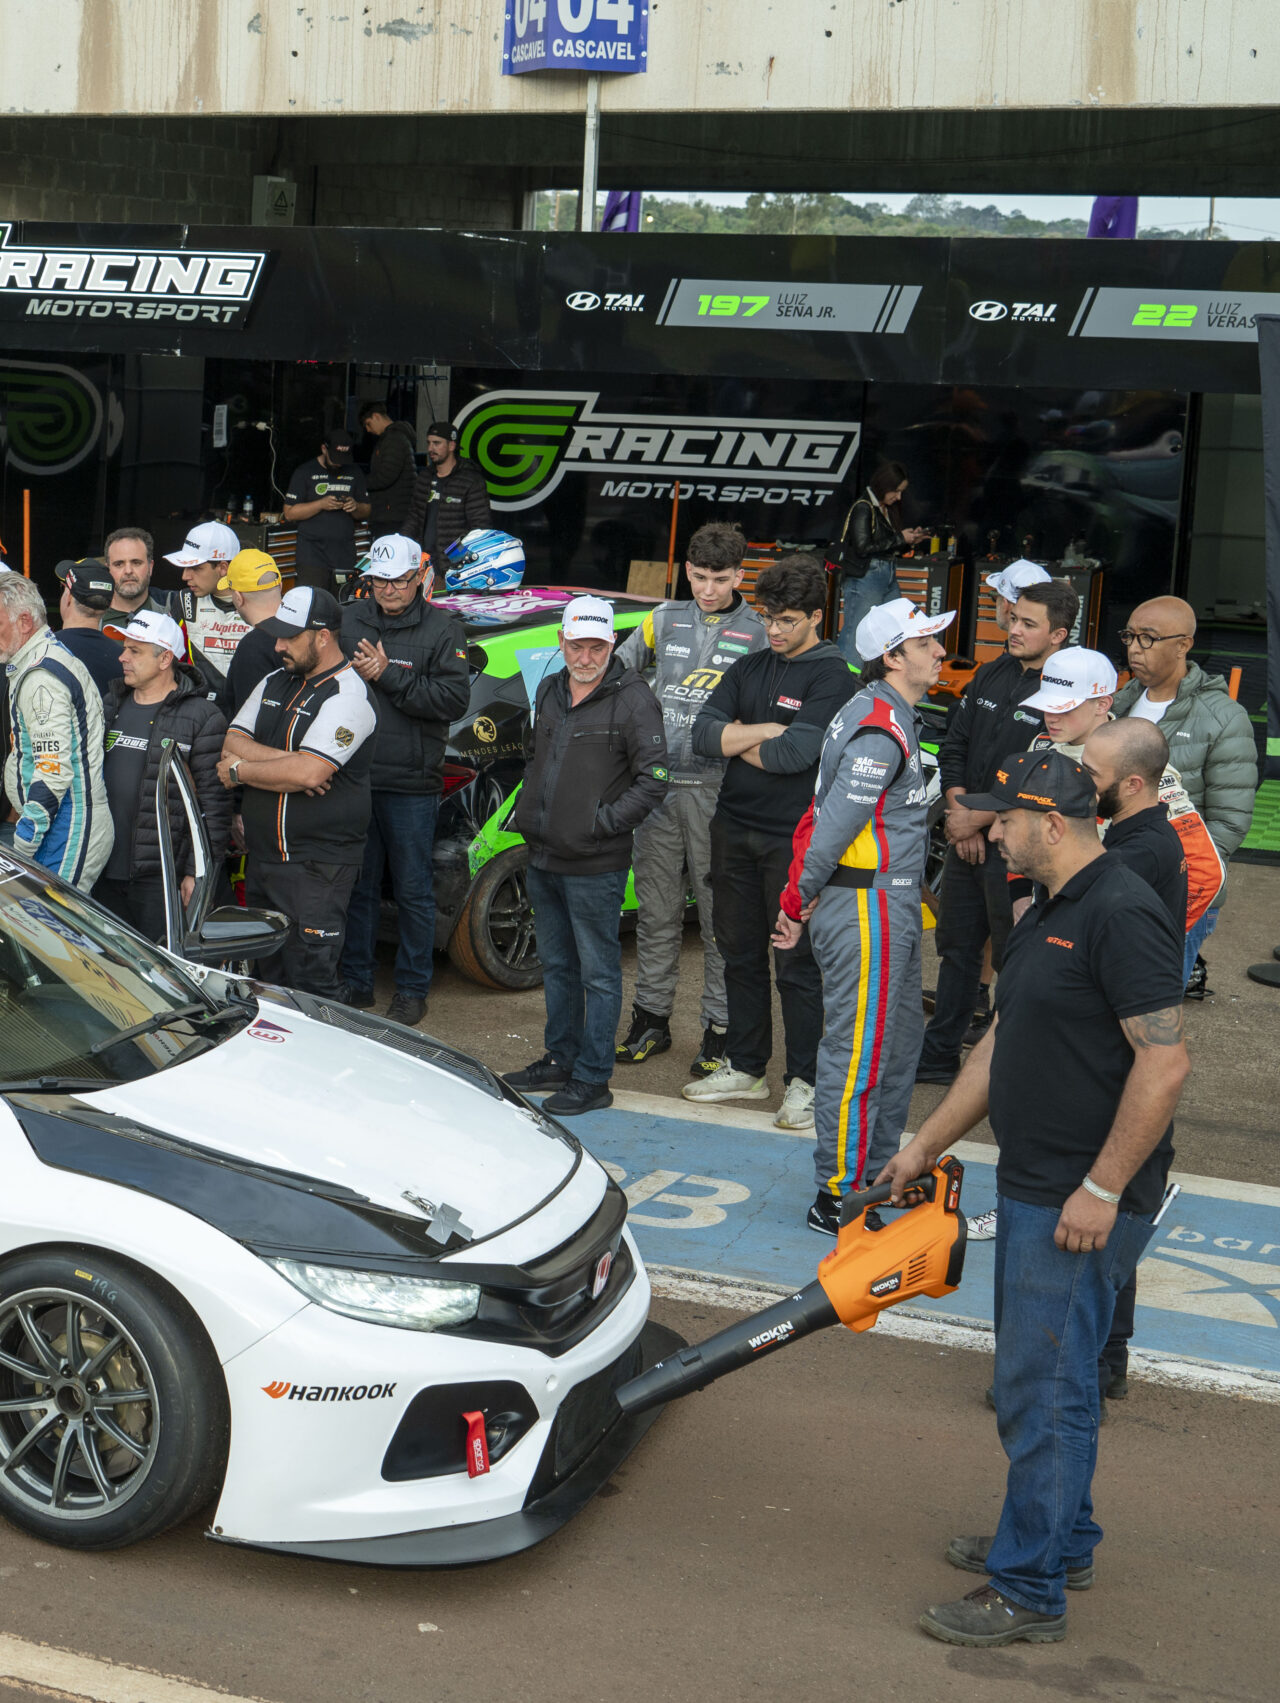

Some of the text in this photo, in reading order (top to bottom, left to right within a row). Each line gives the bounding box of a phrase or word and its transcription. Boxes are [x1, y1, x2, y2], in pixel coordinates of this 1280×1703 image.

[511, 39, 546, 63] CASCAVEL
[552, 38, 636, 60] CASCAVEL
[604, 293, 645, 307] TAI
[697, 294, 770, 317] 197
[777, 293, 808, 305] LUIZ
[25, 298, 240, 323] MOTORSPORT
[776, 305, 837, 319] SENA JR.
[1012, 302, 1058, 316] TAI
[1131, 303, 1199, 327] 22
[1207, 302, 1242, 315] LUIZ
[563, 426, 846, 468] RACING
[599, 480, 834, 507] MOTORSPORT
[212, 549, 226, 559] 1st
[209, 623, 250, 636] Jupiter
[1091, 683, 1107, 695] 1st
[460, 745, 498, 759] MENDES
[856, 756, 874, 767] SÃO
[852, 764, 887, 777] CAETANO
[871, 1276, 900, 1294] WOKIN
[748, 1320, 795, 1349] WOKIN
[473, 1438, 485, 1472] sparco
